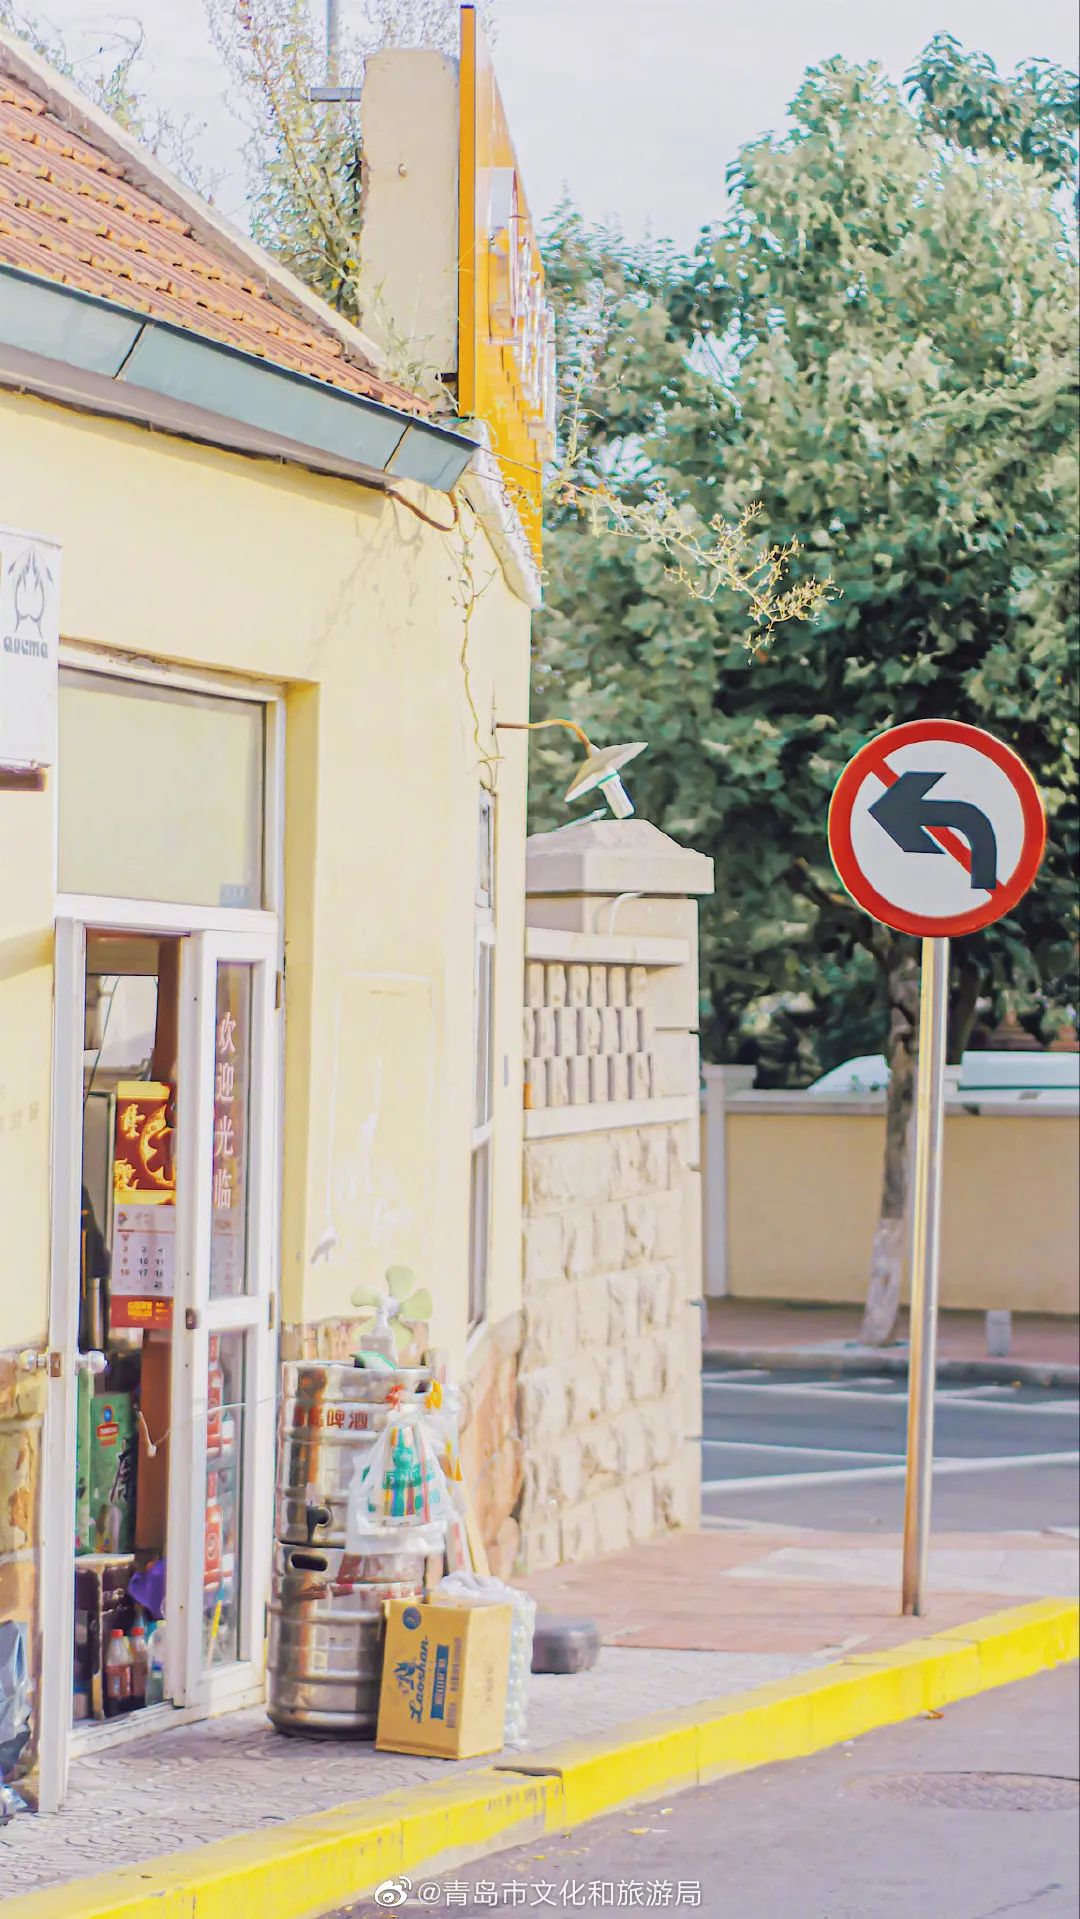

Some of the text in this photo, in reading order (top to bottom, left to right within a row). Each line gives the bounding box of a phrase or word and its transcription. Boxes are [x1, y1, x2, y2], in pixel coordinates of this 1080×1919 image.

[214, 1011, 236, 1209] 欢迎光临
[409, 1634, 429, 1724] Laoshan
